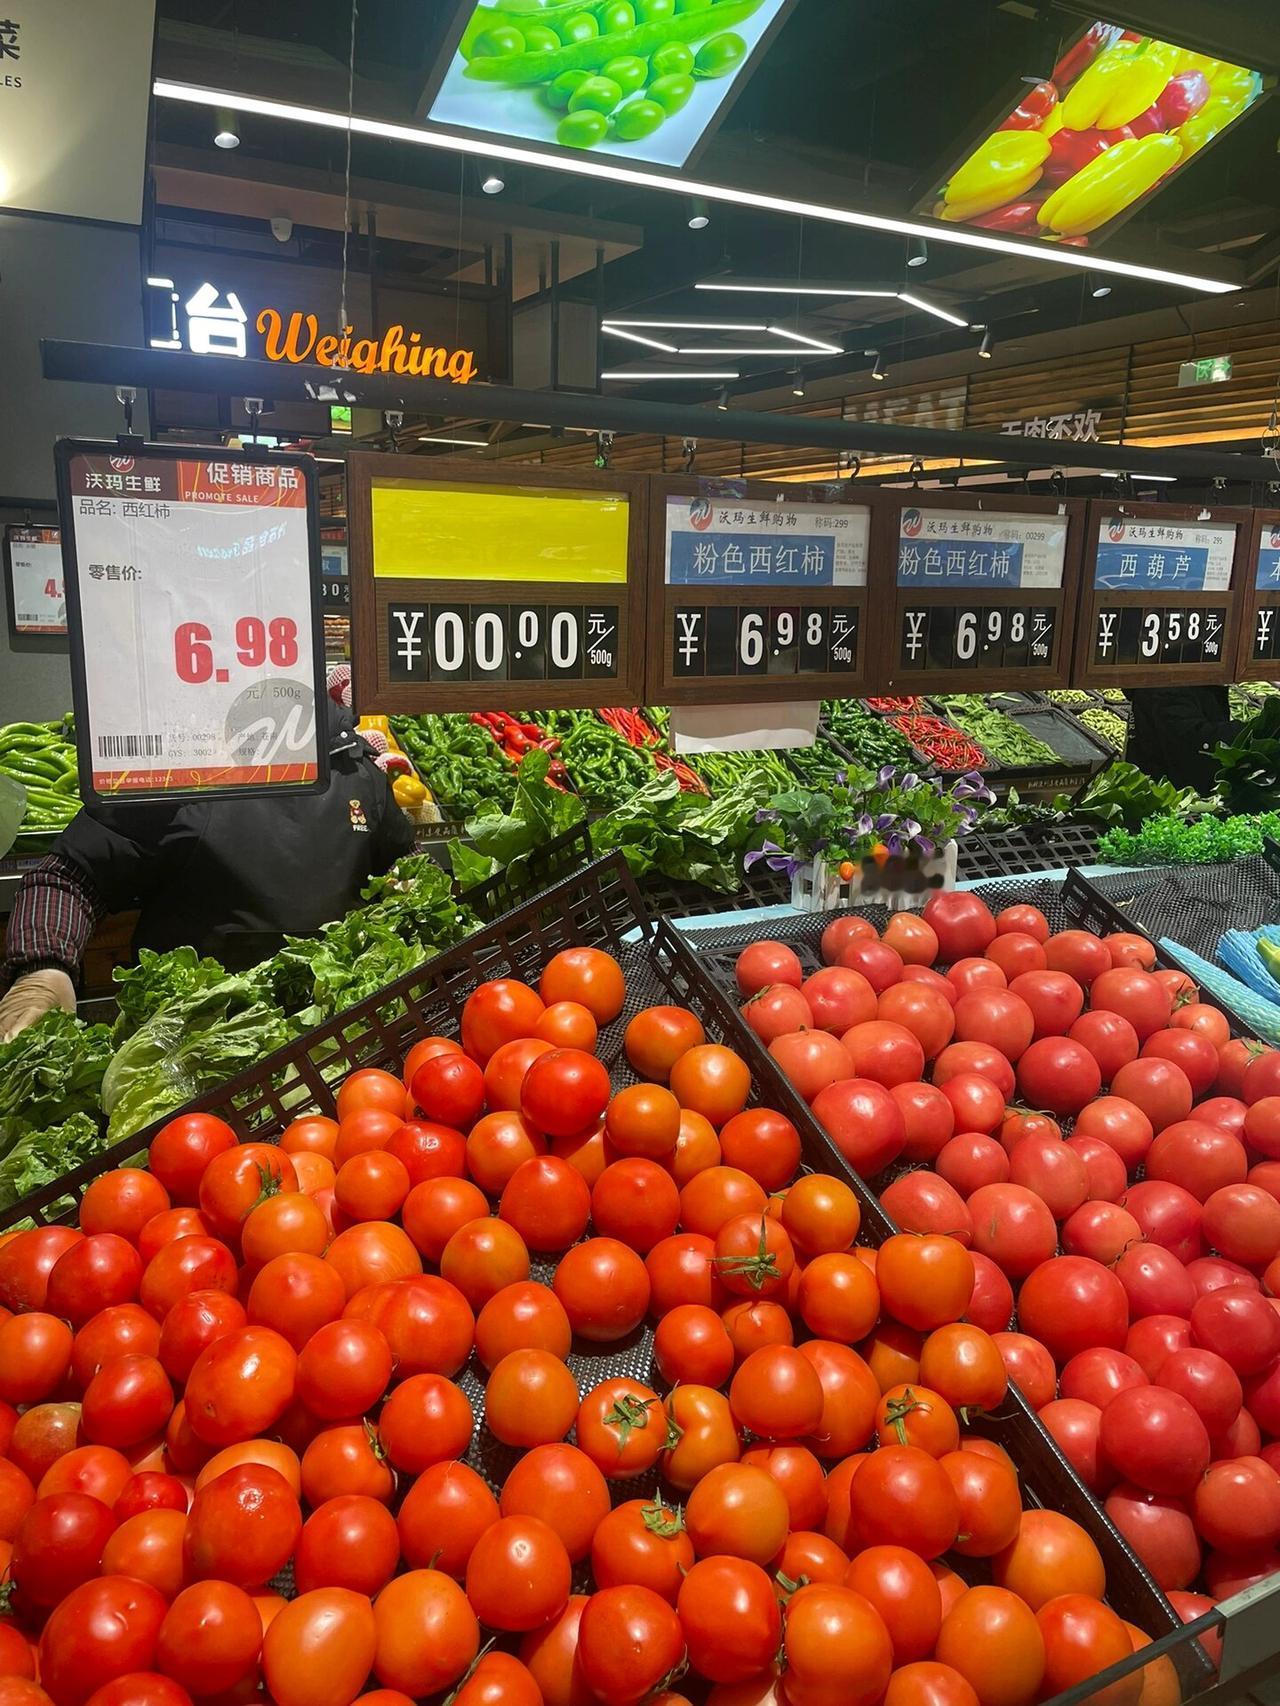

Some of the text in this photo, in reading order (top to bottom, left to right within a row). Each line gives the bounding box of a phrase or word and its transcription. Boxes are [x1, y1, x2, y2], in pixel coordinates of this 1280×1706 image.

[147, 277, 247, 358] 台
[256, 308, 478, 384] Weighing
[86, 473, 161, 492] 沃玛生鲜
[207, 462, 298, 489] 促销商品
[185, 491, 259, 503] PROMOTE SALE
[79, 499, 170, 519] 品名: 西红柿
[719, 511, 797, 527] 沃玛生鲜购物
[926, 521, 993, 537] 沃玛生鲜购物
[1128, 526, 1184, 541] 沃玛生鲜购物
[692, 542, 825, 576] 粉色西红柿
[899, 546, 1010, 579] 粉色西红柿
[1119, 553, 1192, 581] 西葫芦
[88, 565, 142, 581] 零售价:
[45, 579, 65, 598] 4.
[174, 616, 298, 684] 6.98
